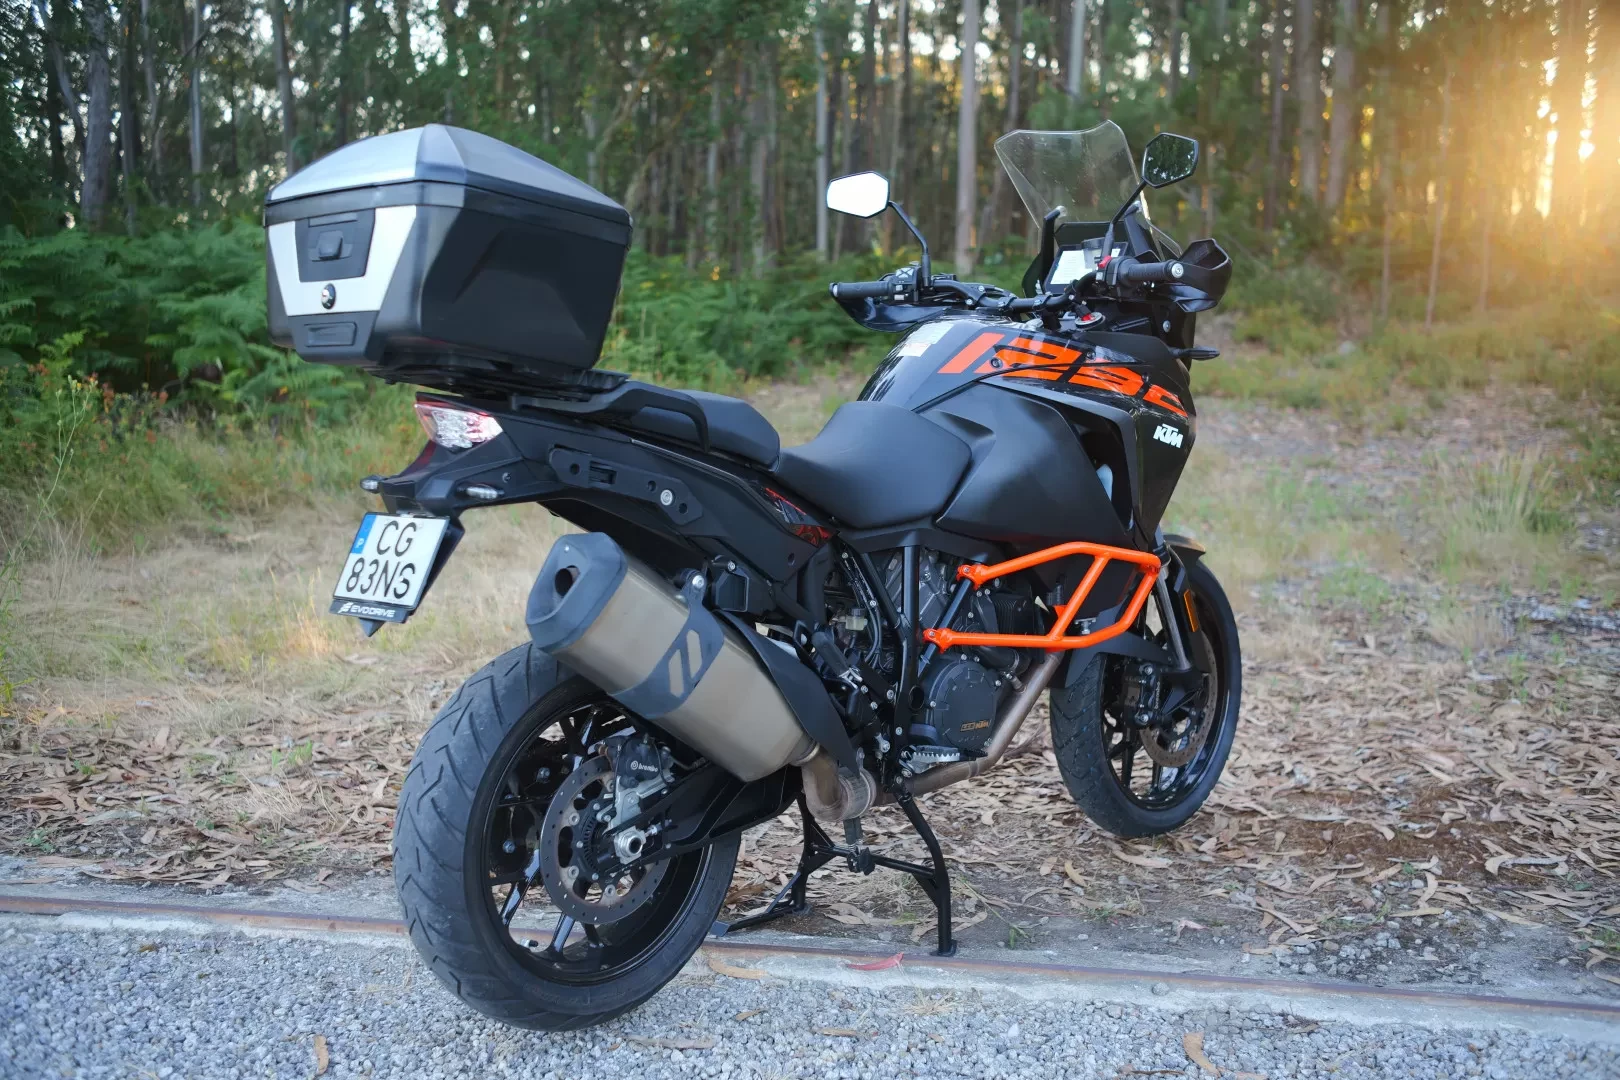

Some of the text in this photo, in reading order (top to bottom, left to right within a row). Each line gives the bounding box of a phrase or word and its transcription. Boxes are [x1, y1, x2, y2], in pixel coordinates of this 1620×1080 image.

[1153, 423, 1184, 448] KTM
[355, 538, 365, 548] P
[376, 520, 417, 557] CG
[346, 557, 416, 599] 83NS
[350, 605, 396, 618] EVODRIVE
[638, 762, 659, 772] brembo
